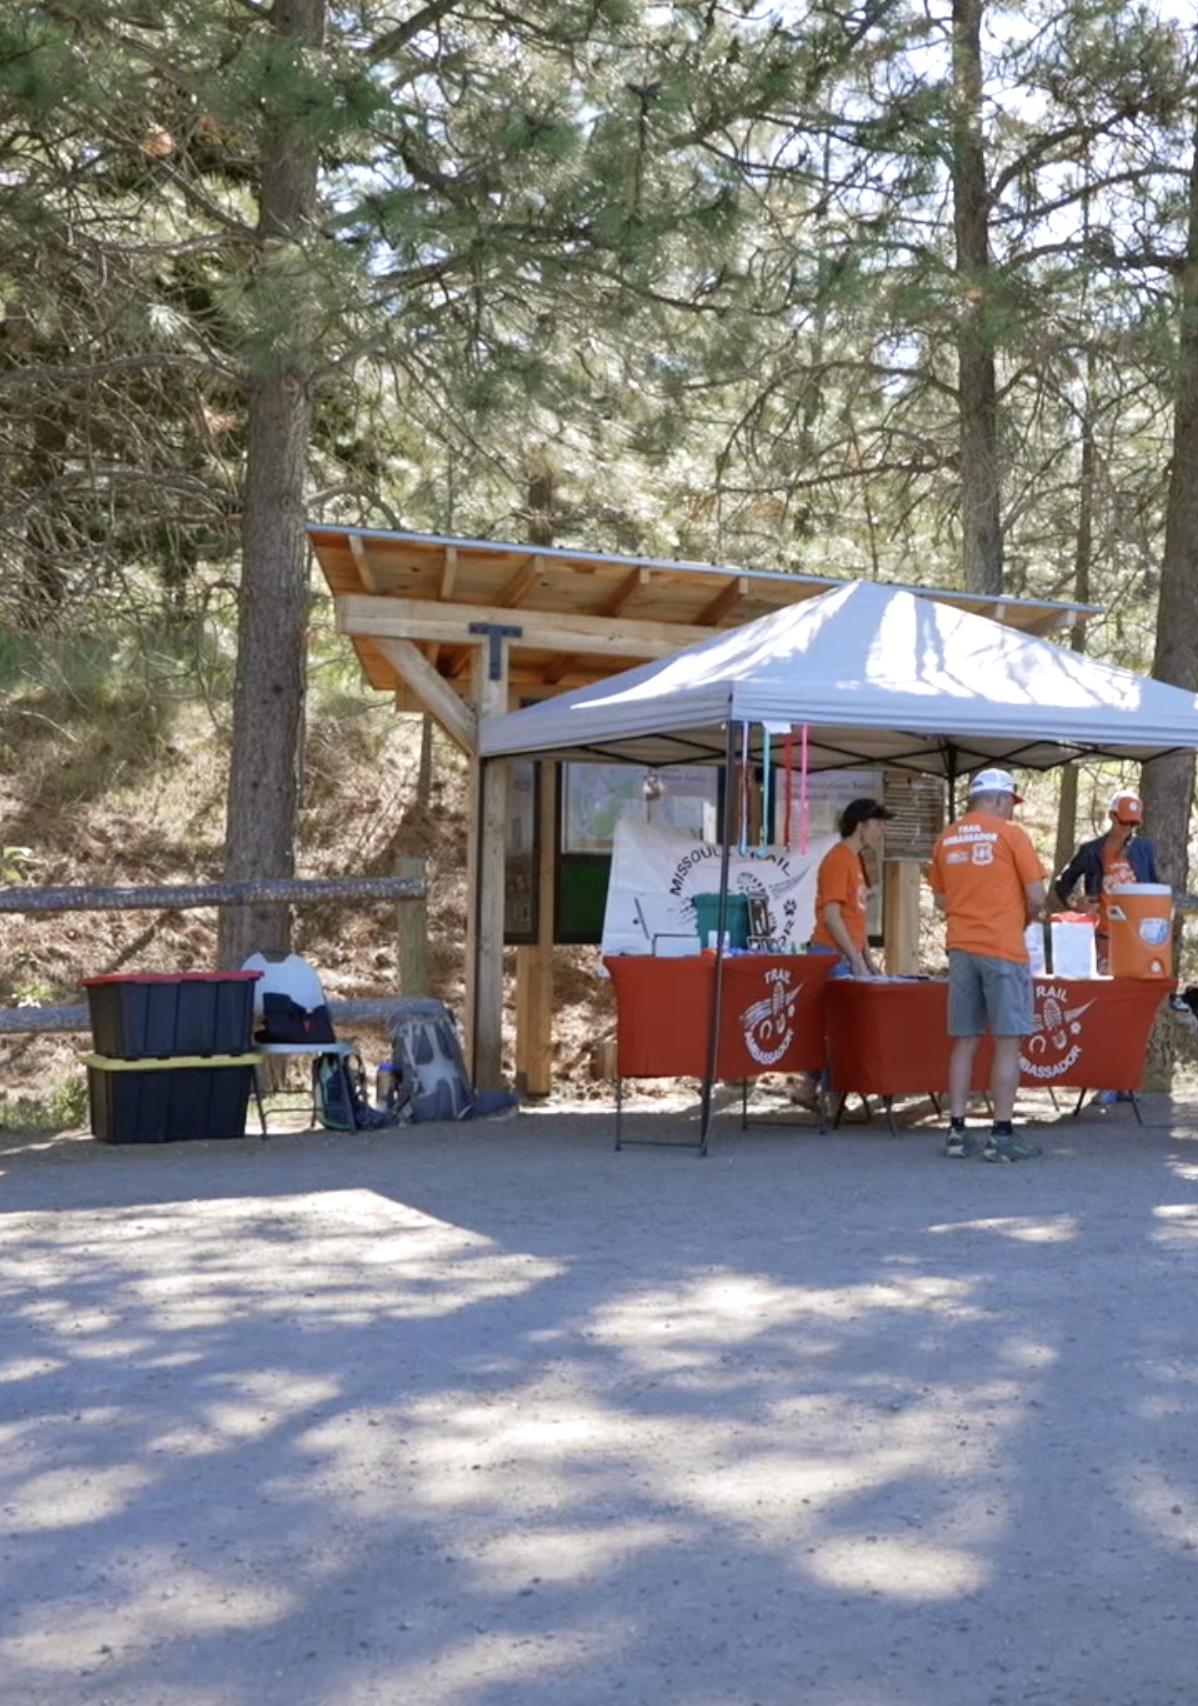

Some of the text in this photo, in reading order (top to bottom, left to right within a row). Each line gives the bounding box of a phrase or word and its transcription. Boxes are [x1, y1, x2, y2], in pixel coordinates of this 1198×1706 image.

[670, 846, 730, 896] MISSOUL
[764, 968, 791, 984] TRAIL
[1036, 986, 1068, 1003] RAIL
